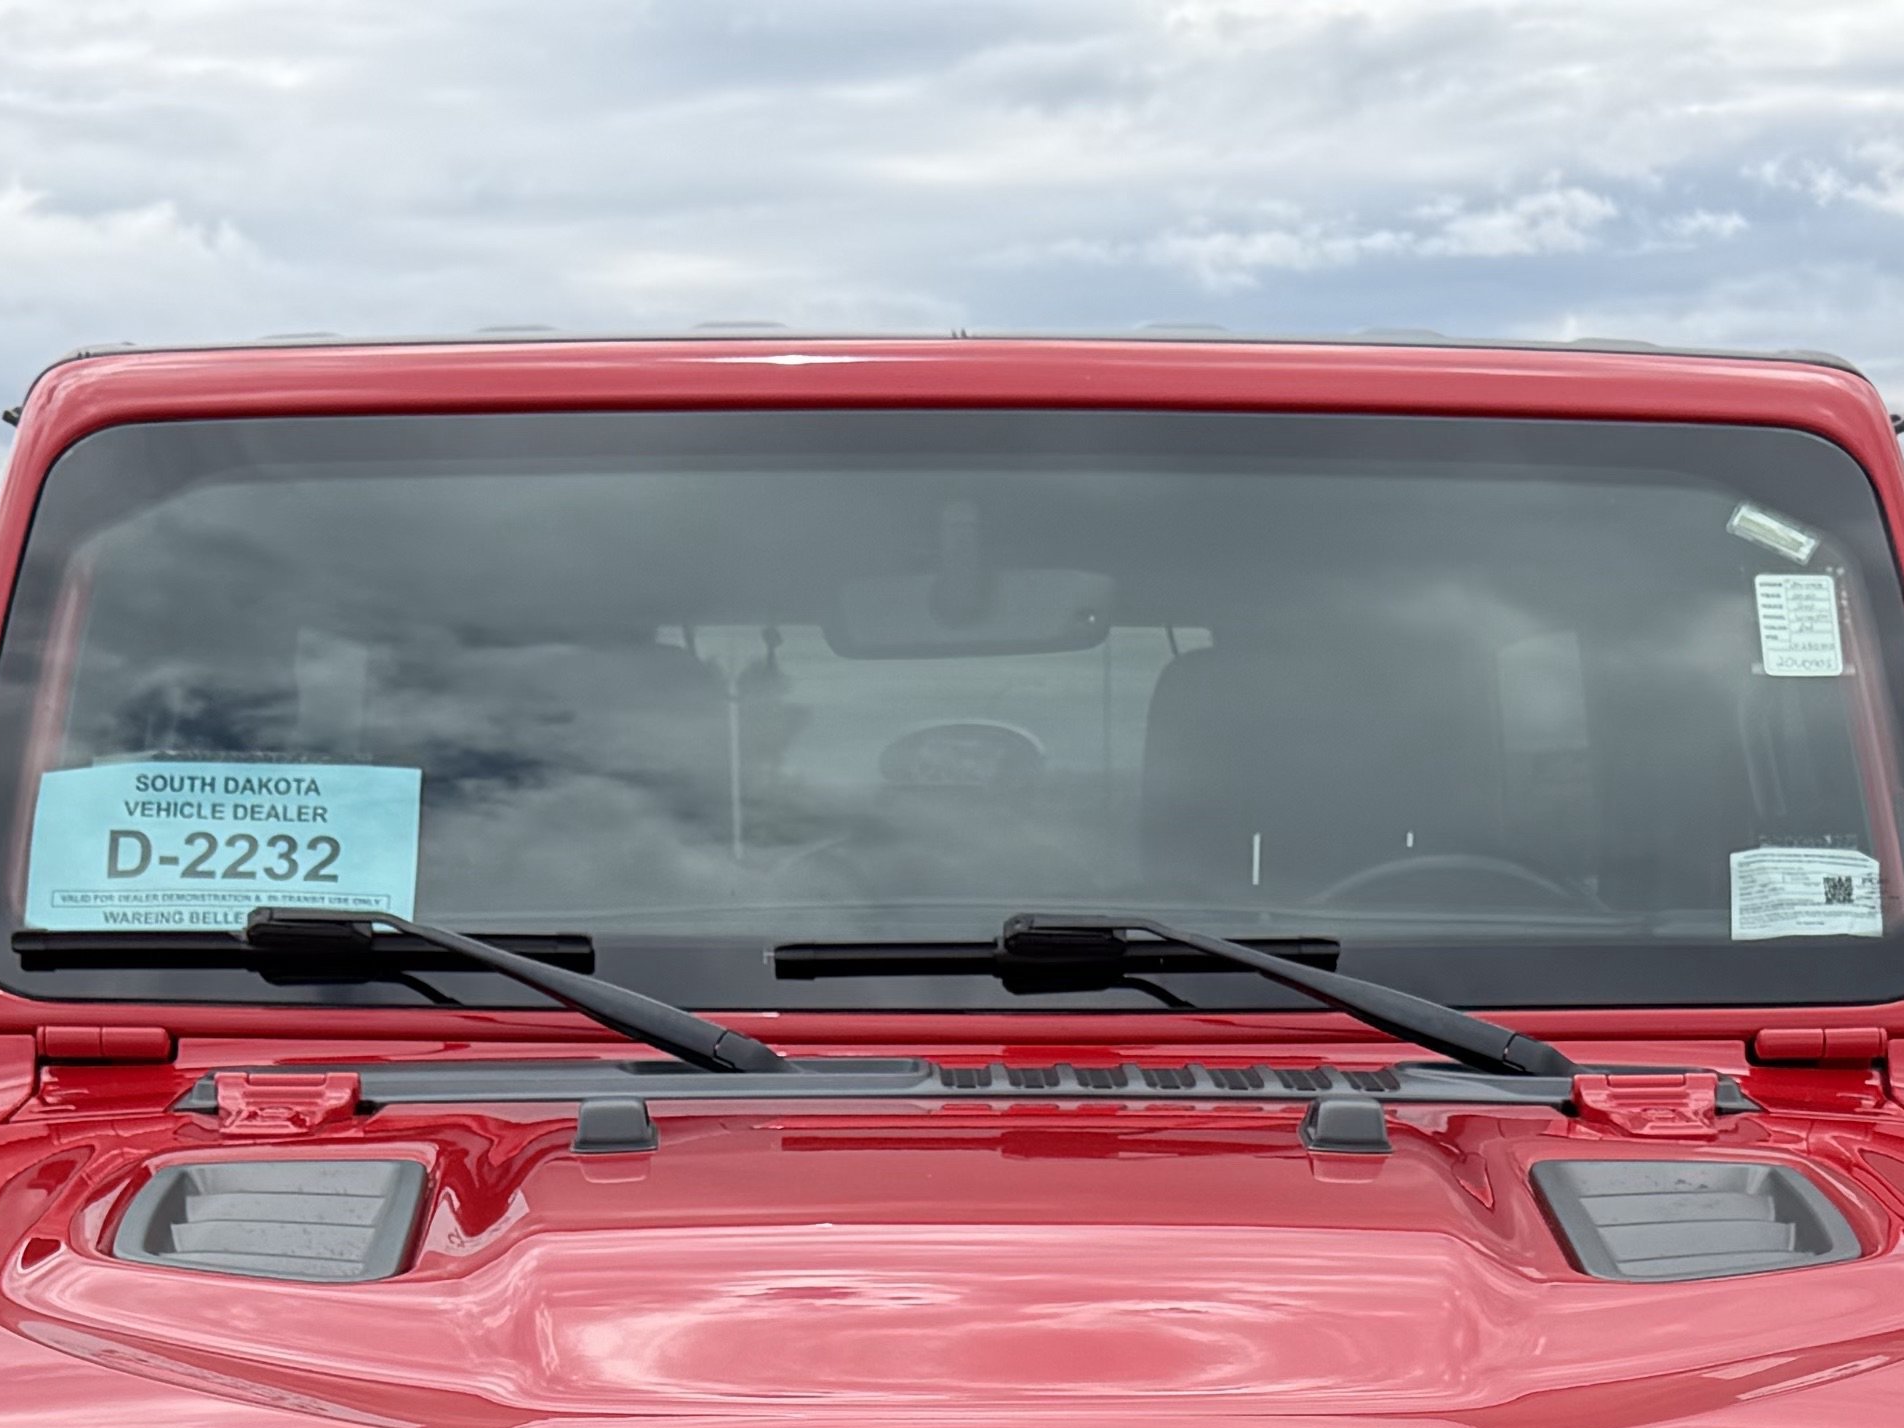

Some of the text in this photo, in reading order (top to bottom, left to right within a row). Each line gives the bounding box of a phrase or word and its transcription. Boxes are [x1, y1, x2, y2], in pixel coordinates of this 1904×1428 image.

[135, 774, 322, 797] SOUTH DAKOTA
[124, 801, 329, 823] VEHICLE DEALER
[107, 829, 342, 884] D-2232
[118, 893, 159, 903] DEALER
[162, 893, 251, 903] DEMONSTRATION
[103, 910, 244, 926] WAREING BELLE
